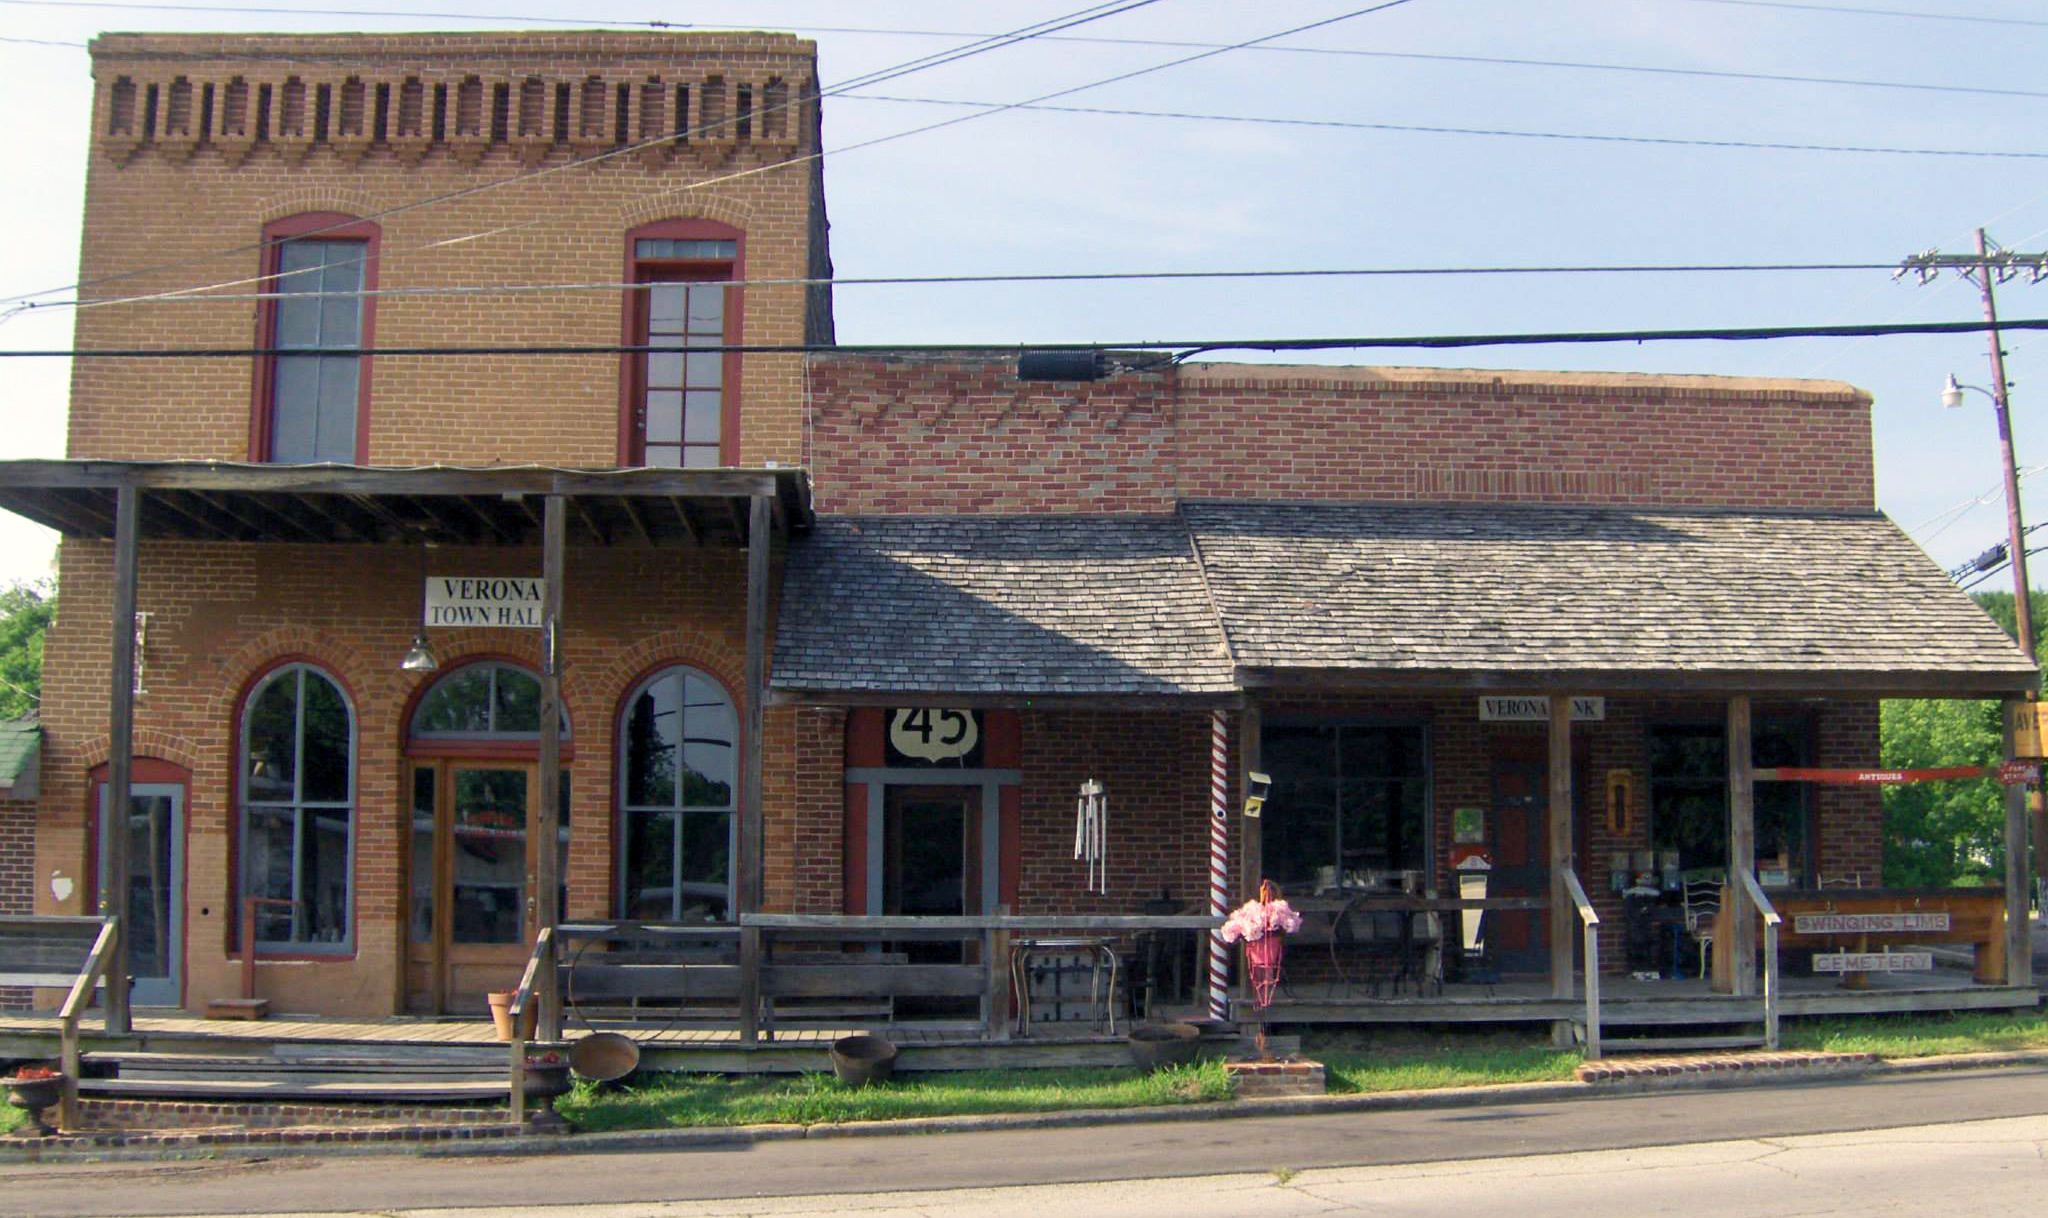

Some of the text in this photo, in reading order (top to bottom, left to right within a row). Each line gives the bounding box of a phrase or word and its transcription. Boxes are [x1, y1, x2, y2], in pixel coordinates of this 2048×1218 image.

[444, 579, 541, 601] VERONA
[431, 605, 539, 626] TOWN HAL
[1484, 699, 1549, 716] VERONA
[902, 707, 967, 745] 45
[1858, 773, 1903, 781] ANTIQUES
[1796, 915, 1894, 931] SWINGING
[1815, 954, 1930, 971] CEMETERY
